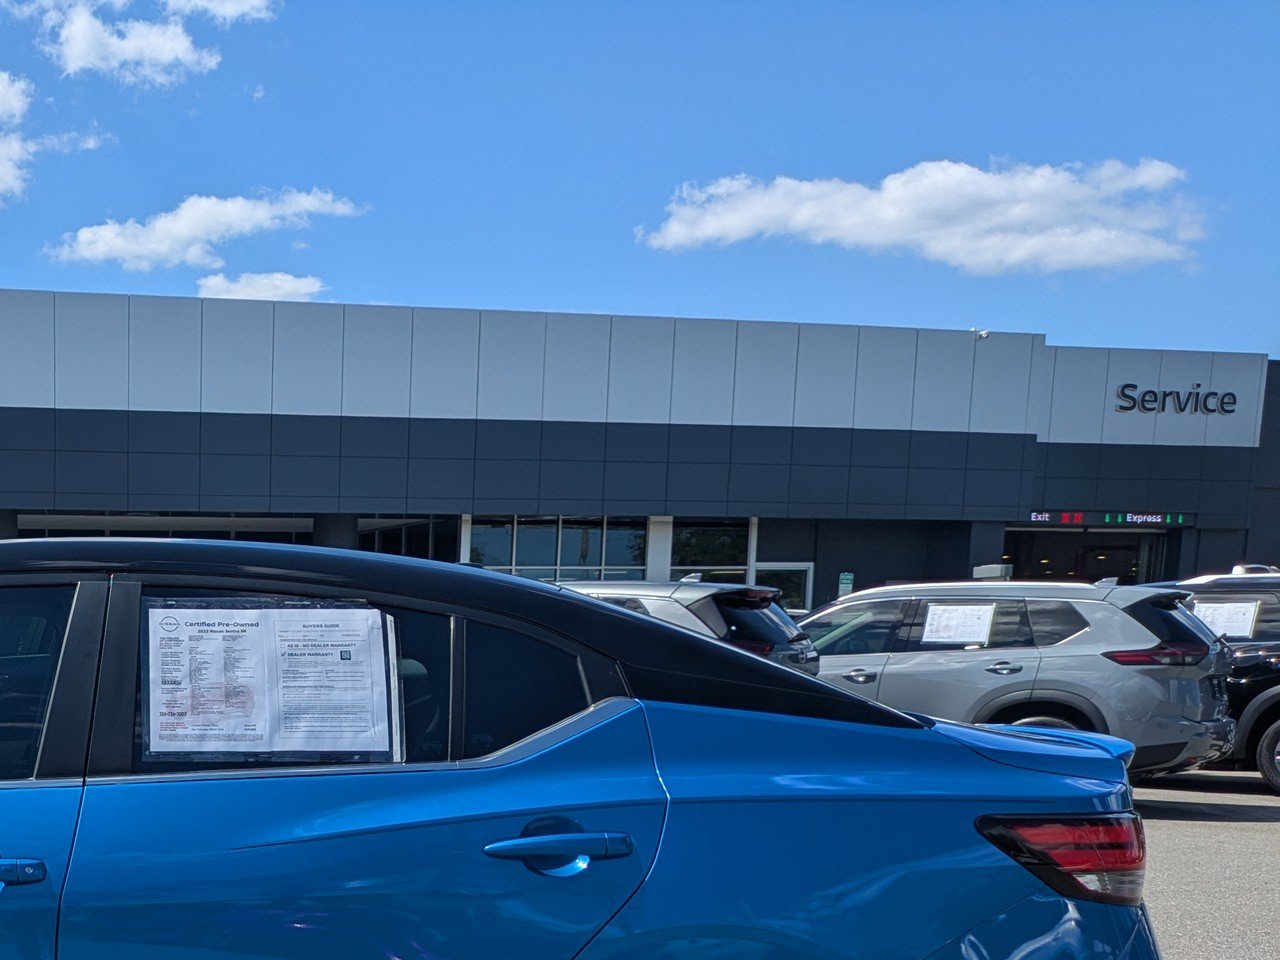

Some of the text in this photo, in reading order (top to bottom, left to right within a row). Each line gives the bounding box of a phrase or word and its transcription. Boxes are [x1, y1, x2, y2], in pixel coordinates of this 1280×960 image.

[1117, 382, 1238, 414] Service
[1030, 512, 1050, 522] Exit
[1126, 513, 1162, 524] Express
